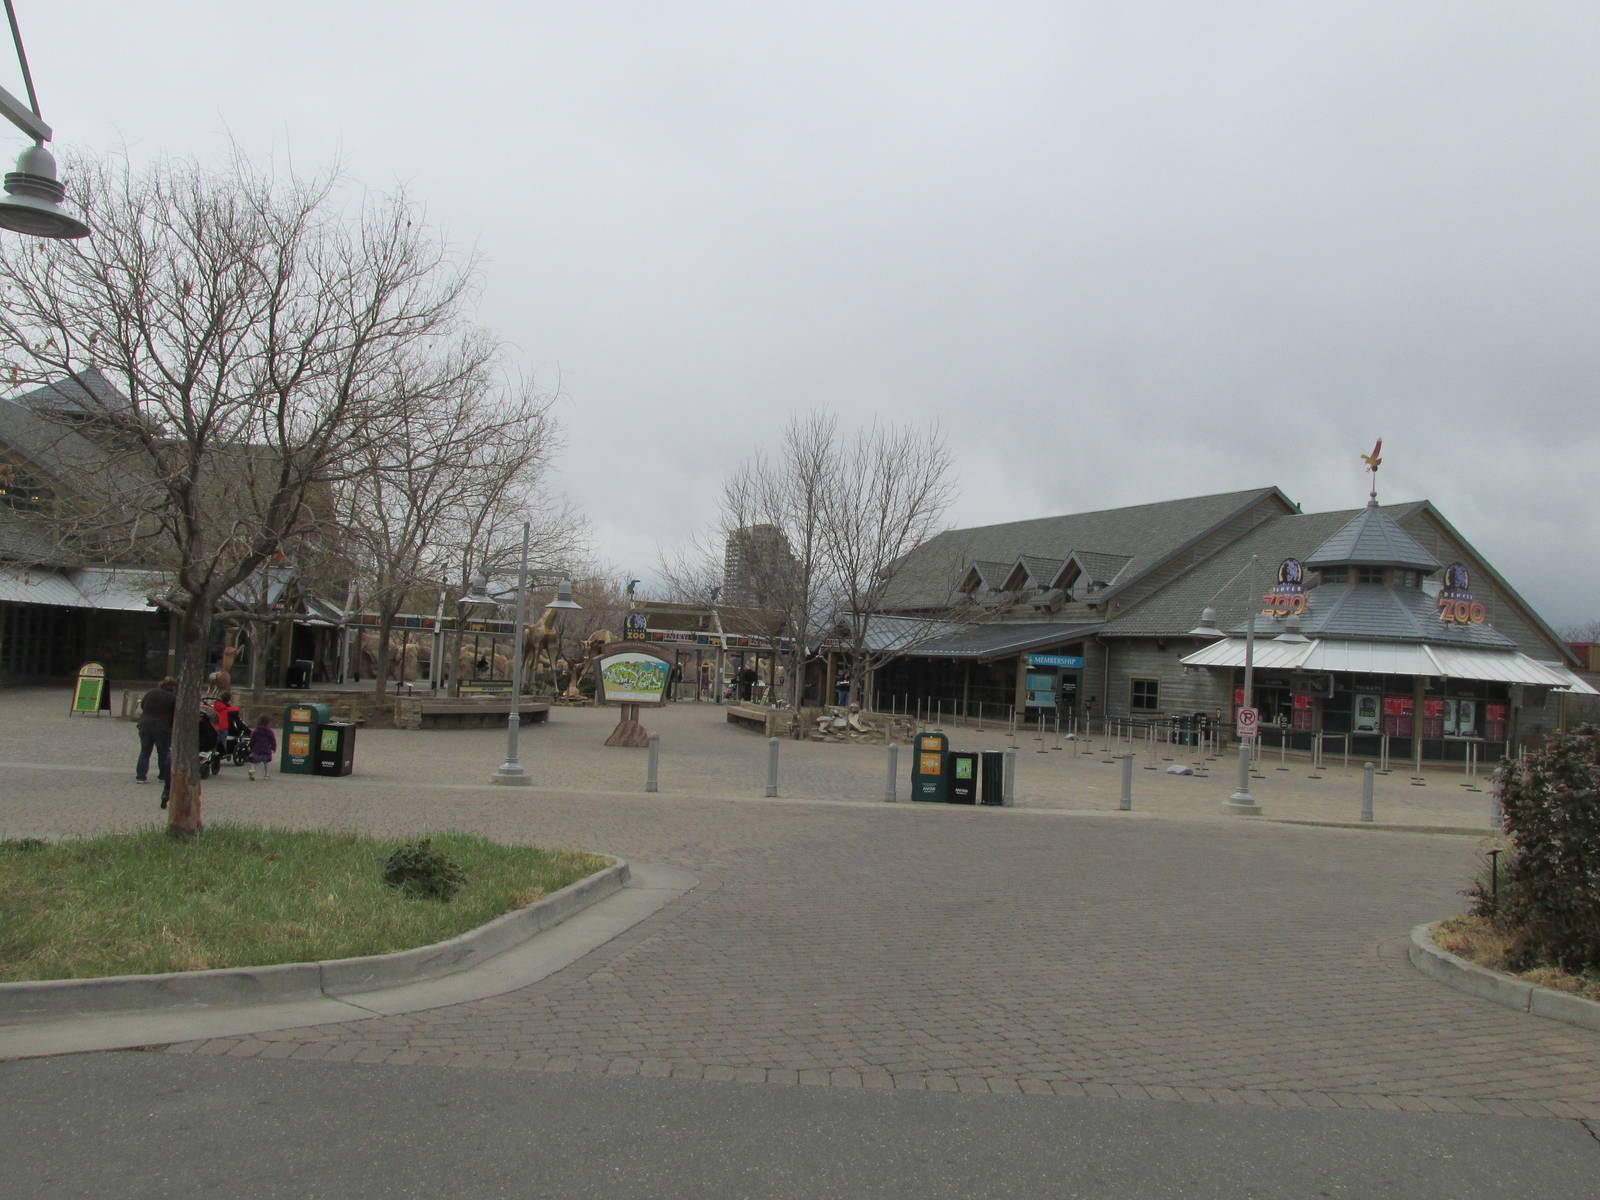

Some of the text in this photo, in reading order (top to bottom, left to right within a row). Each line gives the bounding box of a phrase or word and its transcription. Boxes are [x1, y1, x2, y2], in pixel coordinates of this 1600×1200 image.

[1440, 599, 1485, 624] ZOO
[627, 632, 646, 640] ZOO
[1034, 656, 1077, 665] MEMBERSHIP
